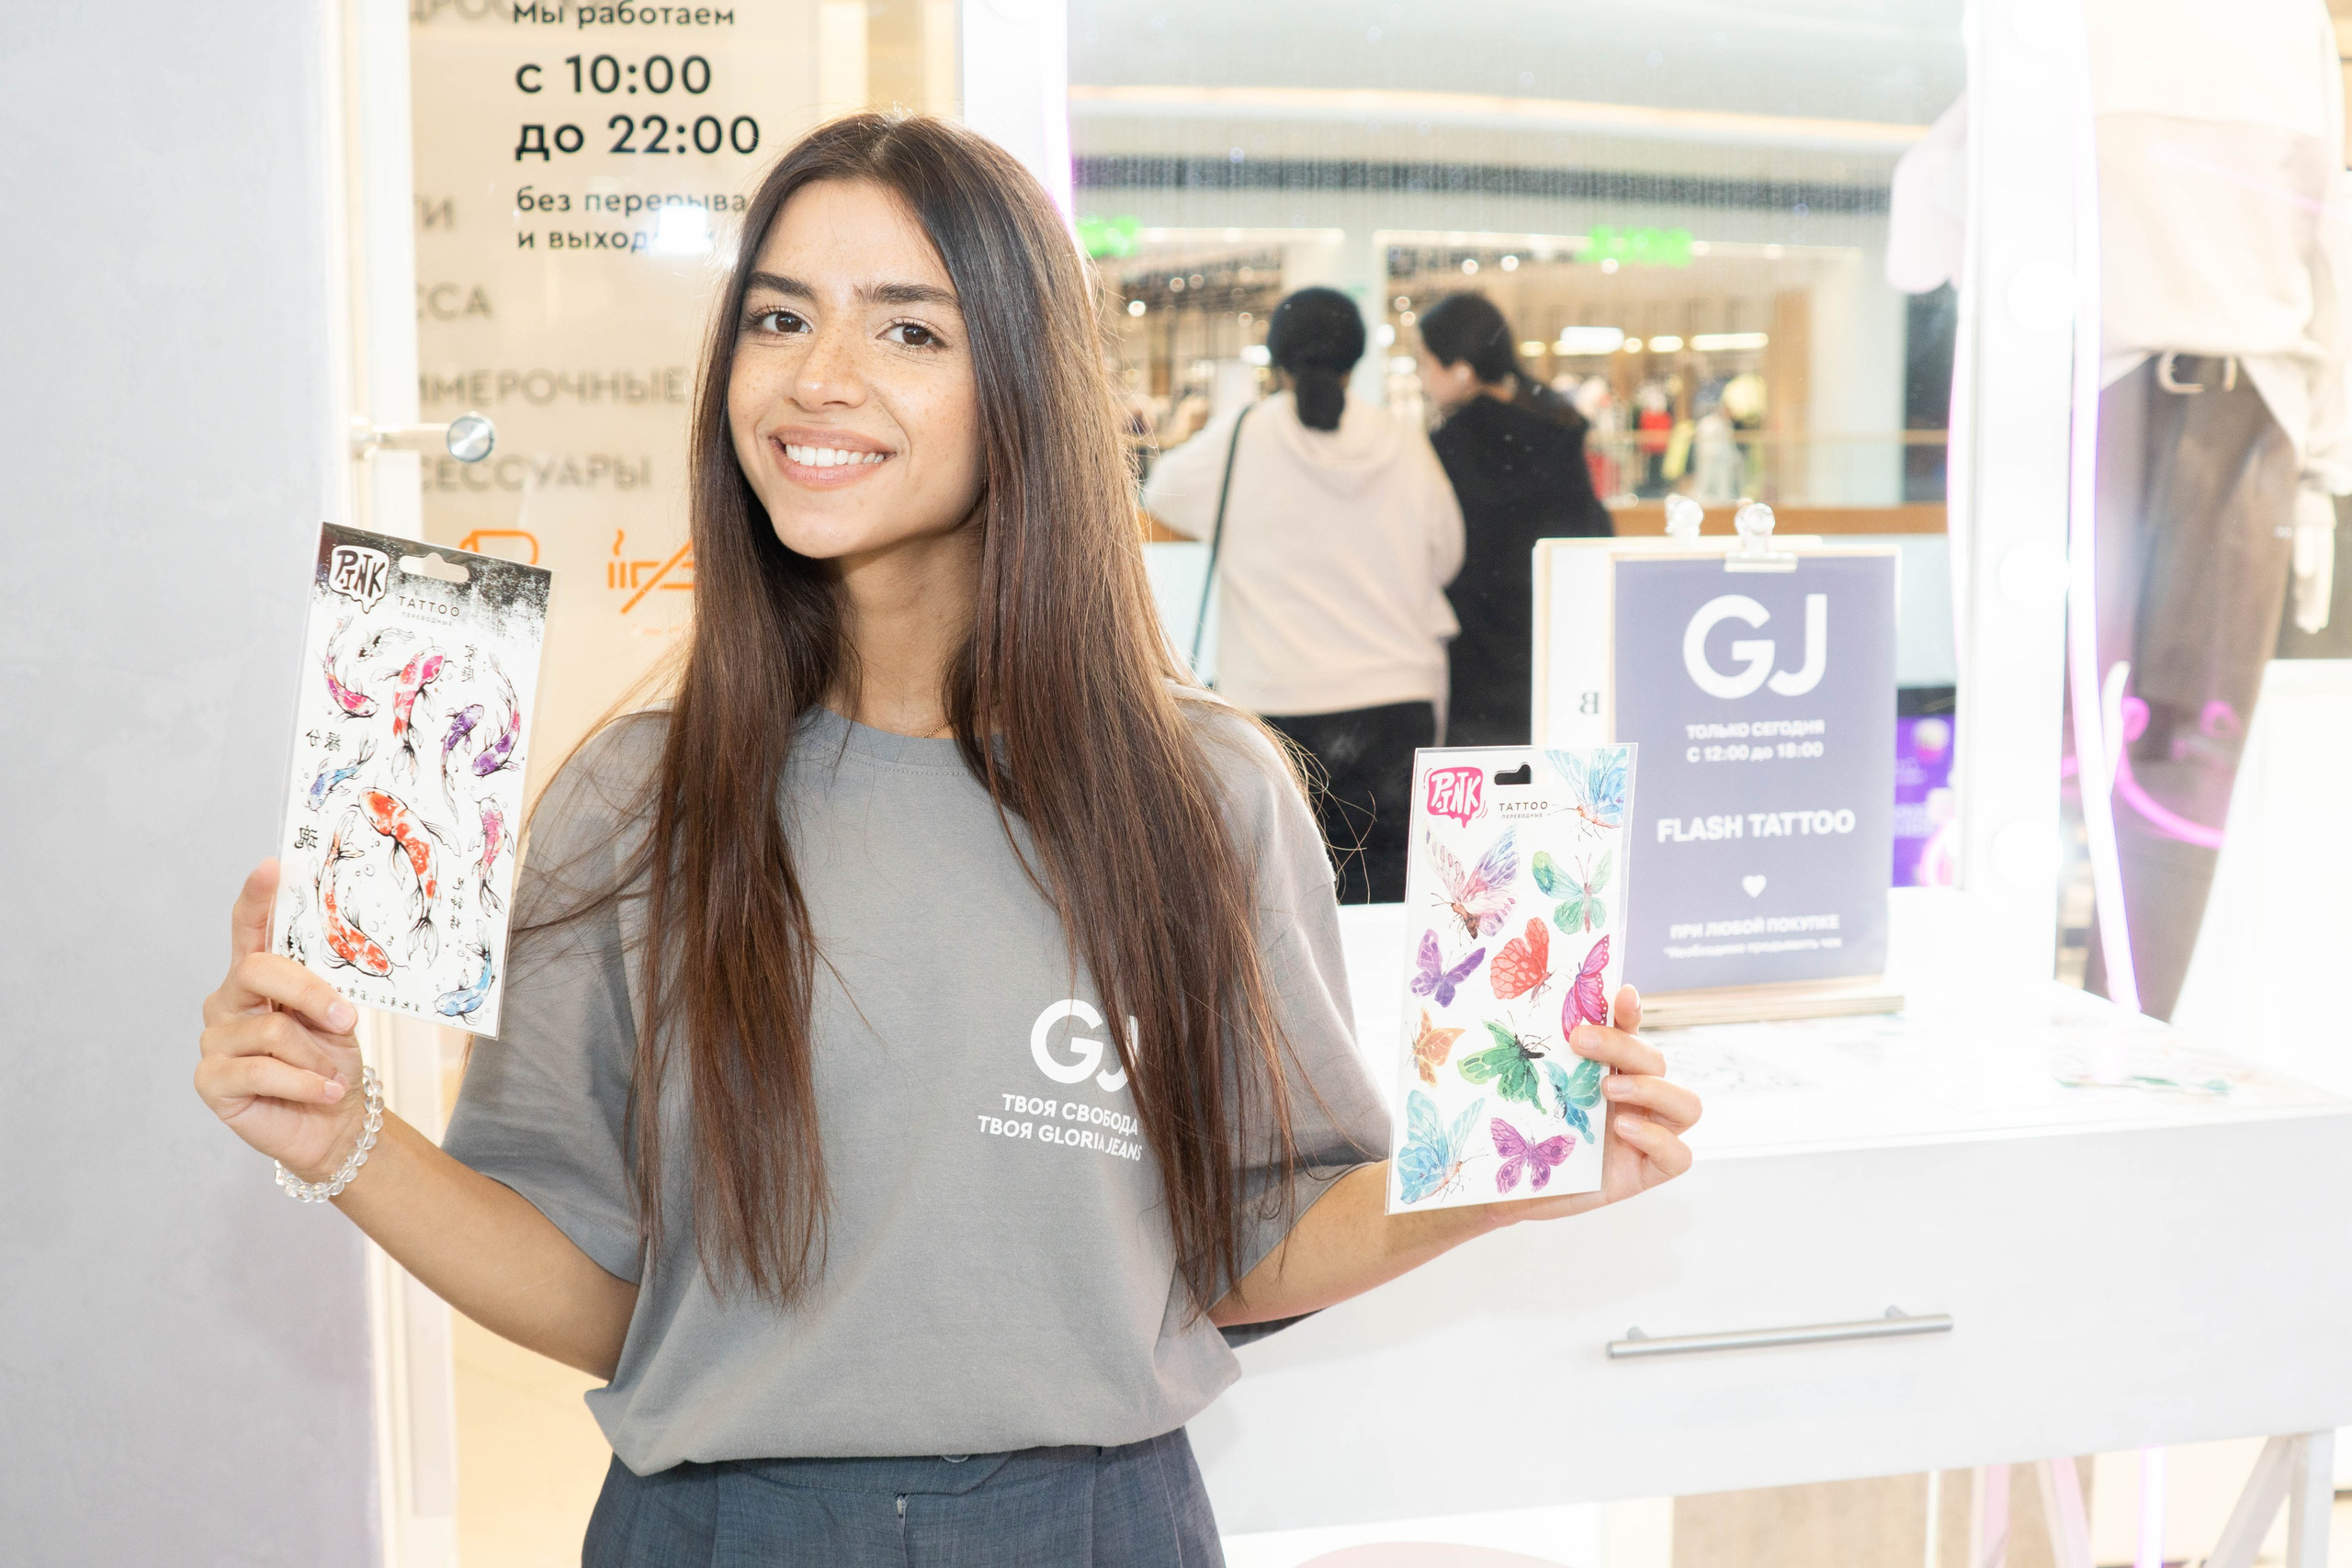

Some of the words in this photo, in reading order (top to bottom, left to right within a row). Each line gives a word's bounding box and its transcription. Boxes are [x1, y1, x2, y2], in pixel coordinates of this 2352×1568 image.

[513, 1, 564, 24] Мы
[578, 0, 735, 29] работаем
[515, 63, 543, 94] с
[564, 54, 712, 95] 10:00
[514, 123, 585, 162] до
[607, 114, 760, 154] 22:00
[517, 185, 571, 212] без
[518, 231, 535, 250] и
[549, 231, 691, 254] выход
[334, 549, 386, 599] PINK
[399, 595, 460, 617] TATTOO
[401, 611, 454, 627] ПЕРЕВОДНЫЕ
[1682, 593, 1827, 700] GJ
[1685, 722, 1750, 740] ТОЛЬКО
[1751, 719, 1826, 738] СЕГОДНЯ
[1703, 744, 1749, 761] 12:00
[1750, 746, 1774, 762] до
[1430, 771, 1481, 815] PINK
[1498, 801, 1548, 812] TATTOO
[1657, 817, 1744, 843] FLASH
[1748, 808, 1856, 840] TATTOO
[1670, 923, 1703, 940] ПРИ
[1705, 917, 1765, 938] ЛЮБОЙ
[1030, 998, 1139, 1093] GJ
[1002, 1093, 1057, 1118] ТВОЯ
[1061, 1102, 1138, 1136] СВОБОДА
[978, 1115, 1034, 1139] ТВОЯ
[1104, 1136, 1142, 1161] JEANS
